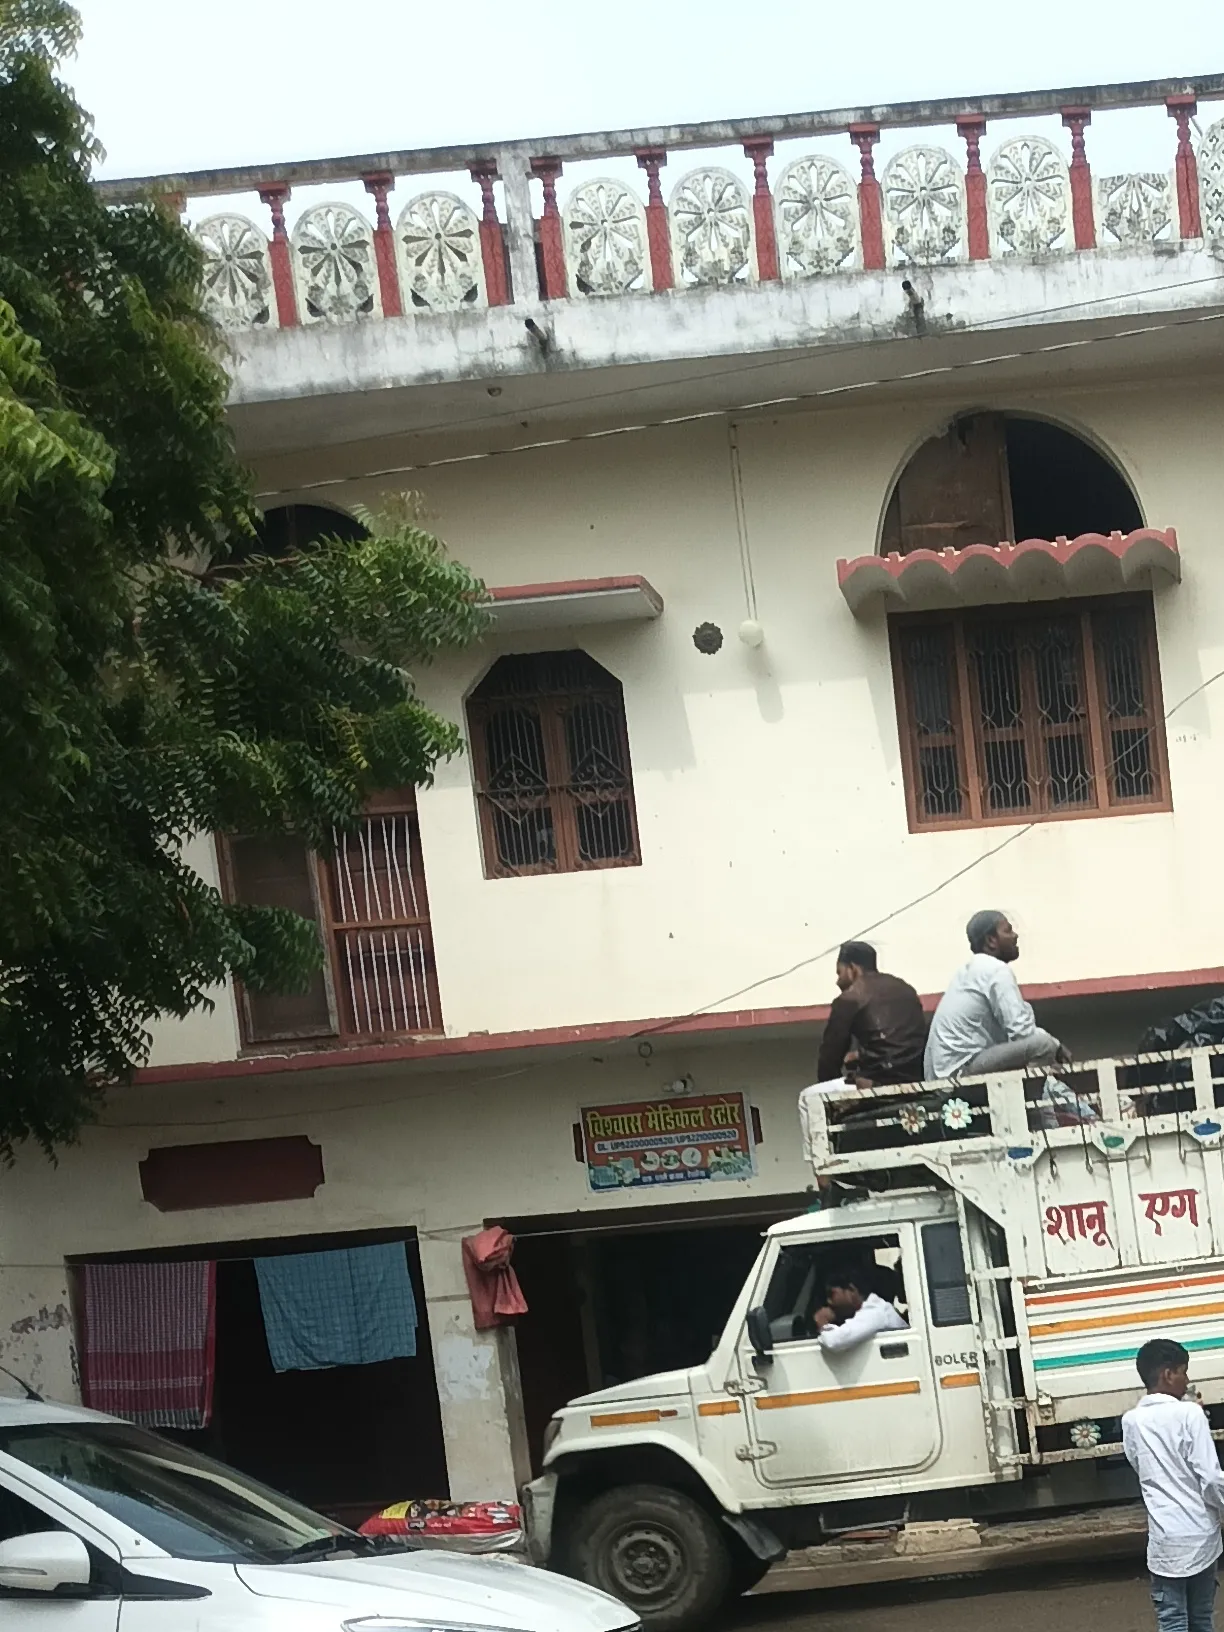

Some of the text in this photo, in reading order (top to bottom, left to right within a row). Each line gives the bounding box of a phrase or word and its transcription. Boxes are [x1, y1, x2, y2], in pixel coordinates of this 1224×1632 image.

[586, 1097, 742, 1138] विश्वास मेडिकल स्टोर
[1045, 1200, 1115, 1250] शानू
[1138, 1188, 1199, 1237] एग
